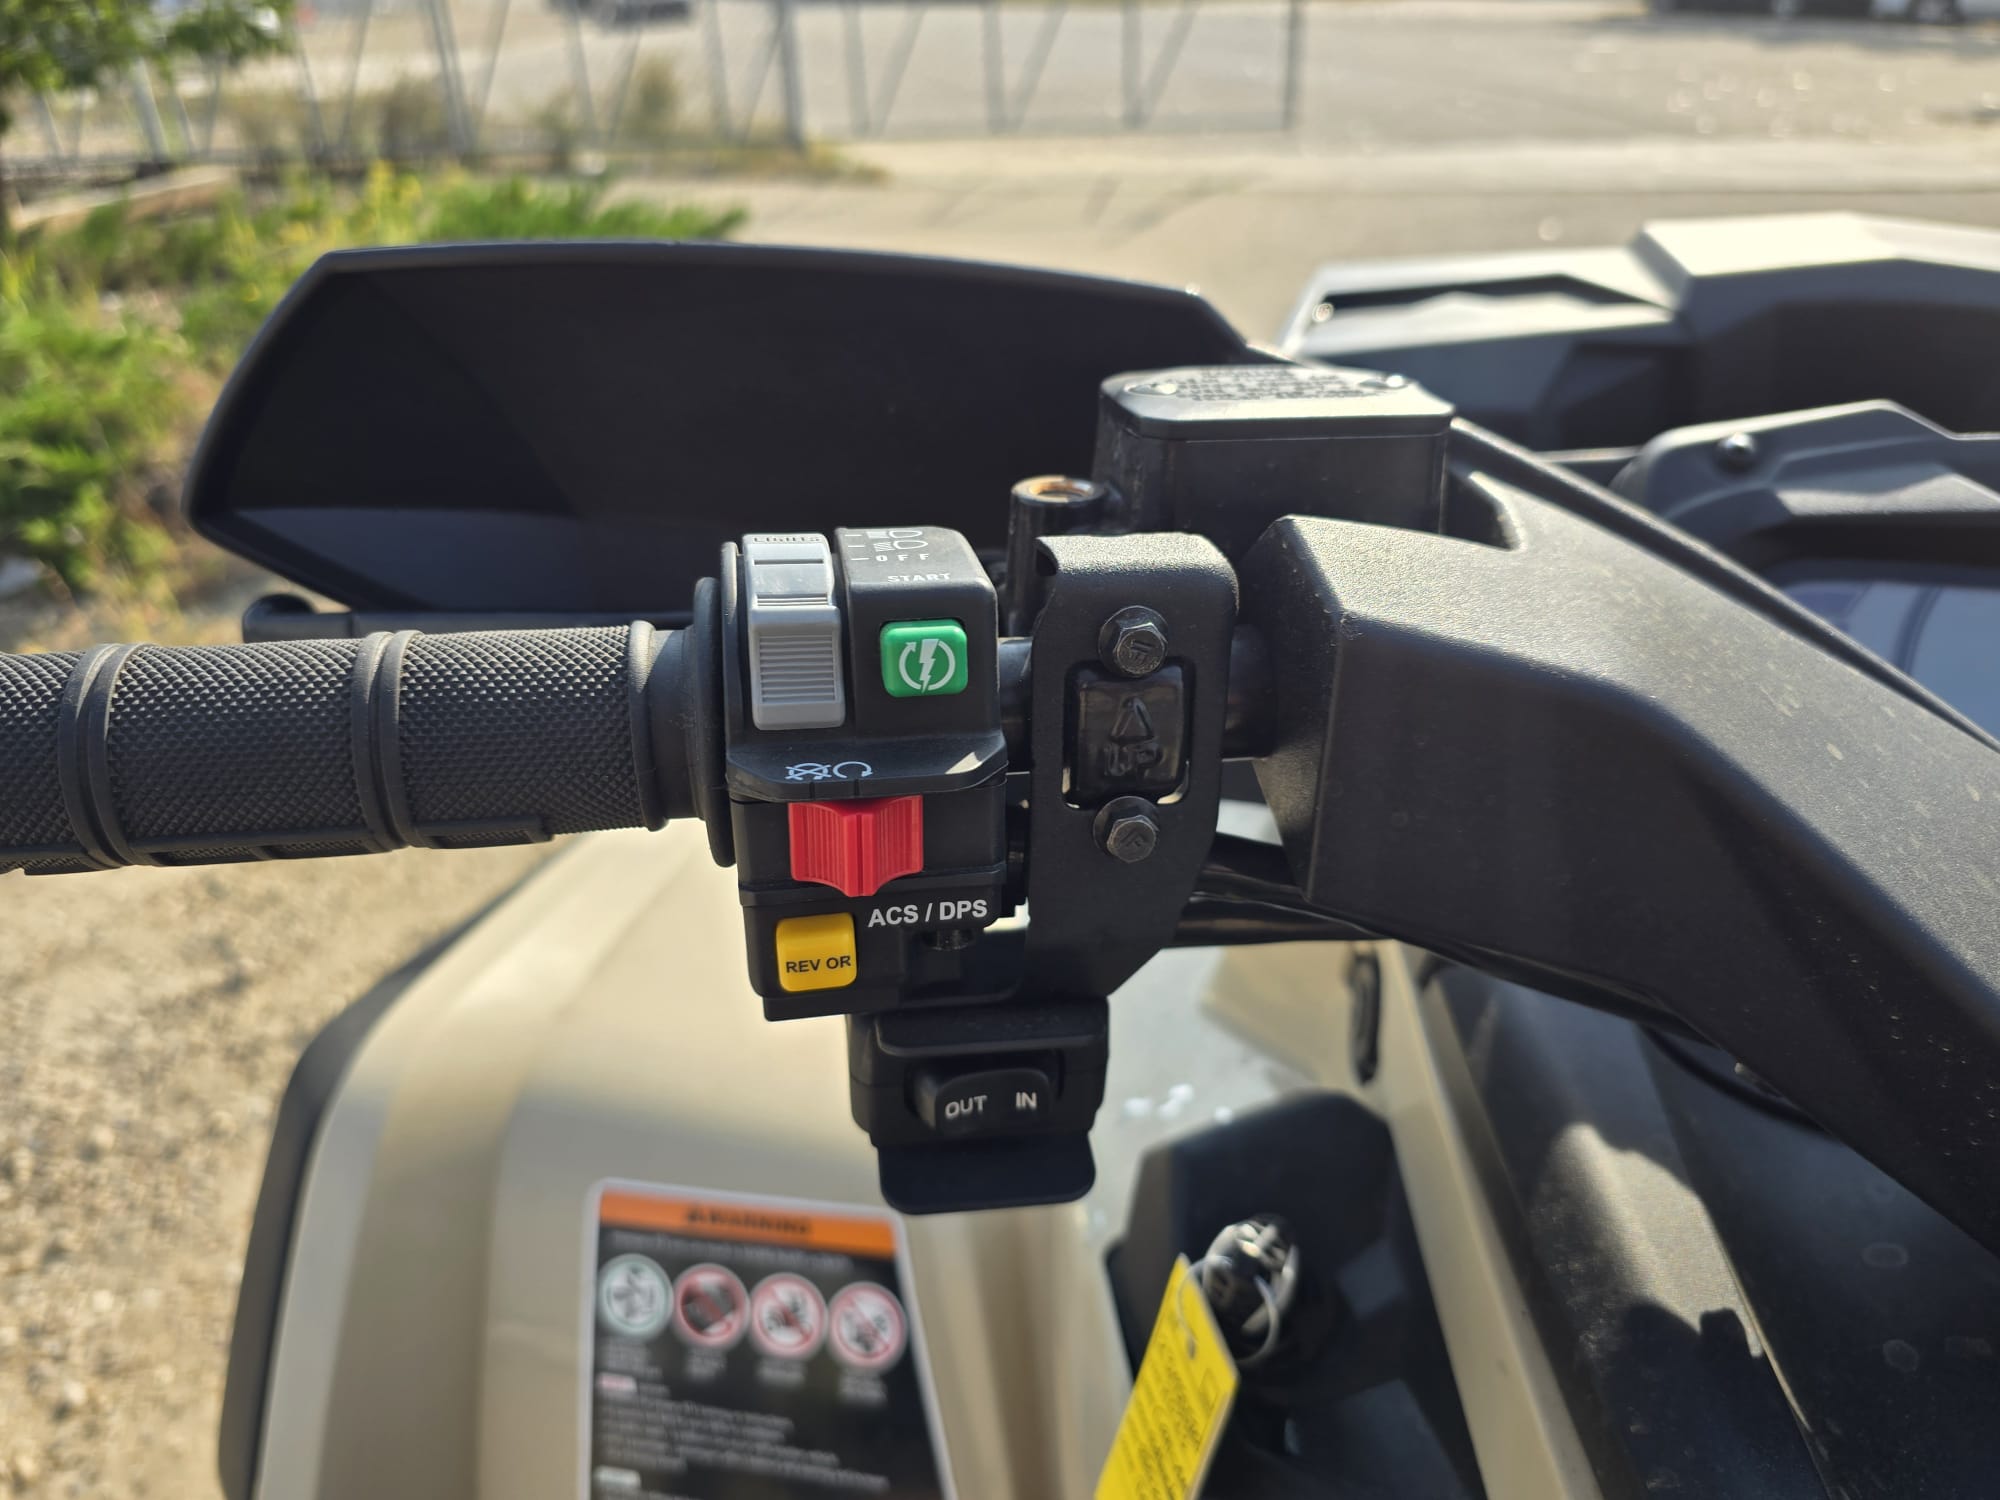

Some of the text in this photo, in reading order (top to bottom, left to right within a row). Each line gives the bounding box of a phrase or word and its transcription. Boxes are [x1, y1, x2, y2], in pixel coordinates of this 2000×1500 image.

[875, 553, 930, 562] OFF
[887, 572, 952, 583] START
[867, 904, 919, 928] ACS
[939, 899, 988, 921] DPS
[785, 954, 852, 974] REV OR
[944, 1091, 1038, 1119] OUT IN
